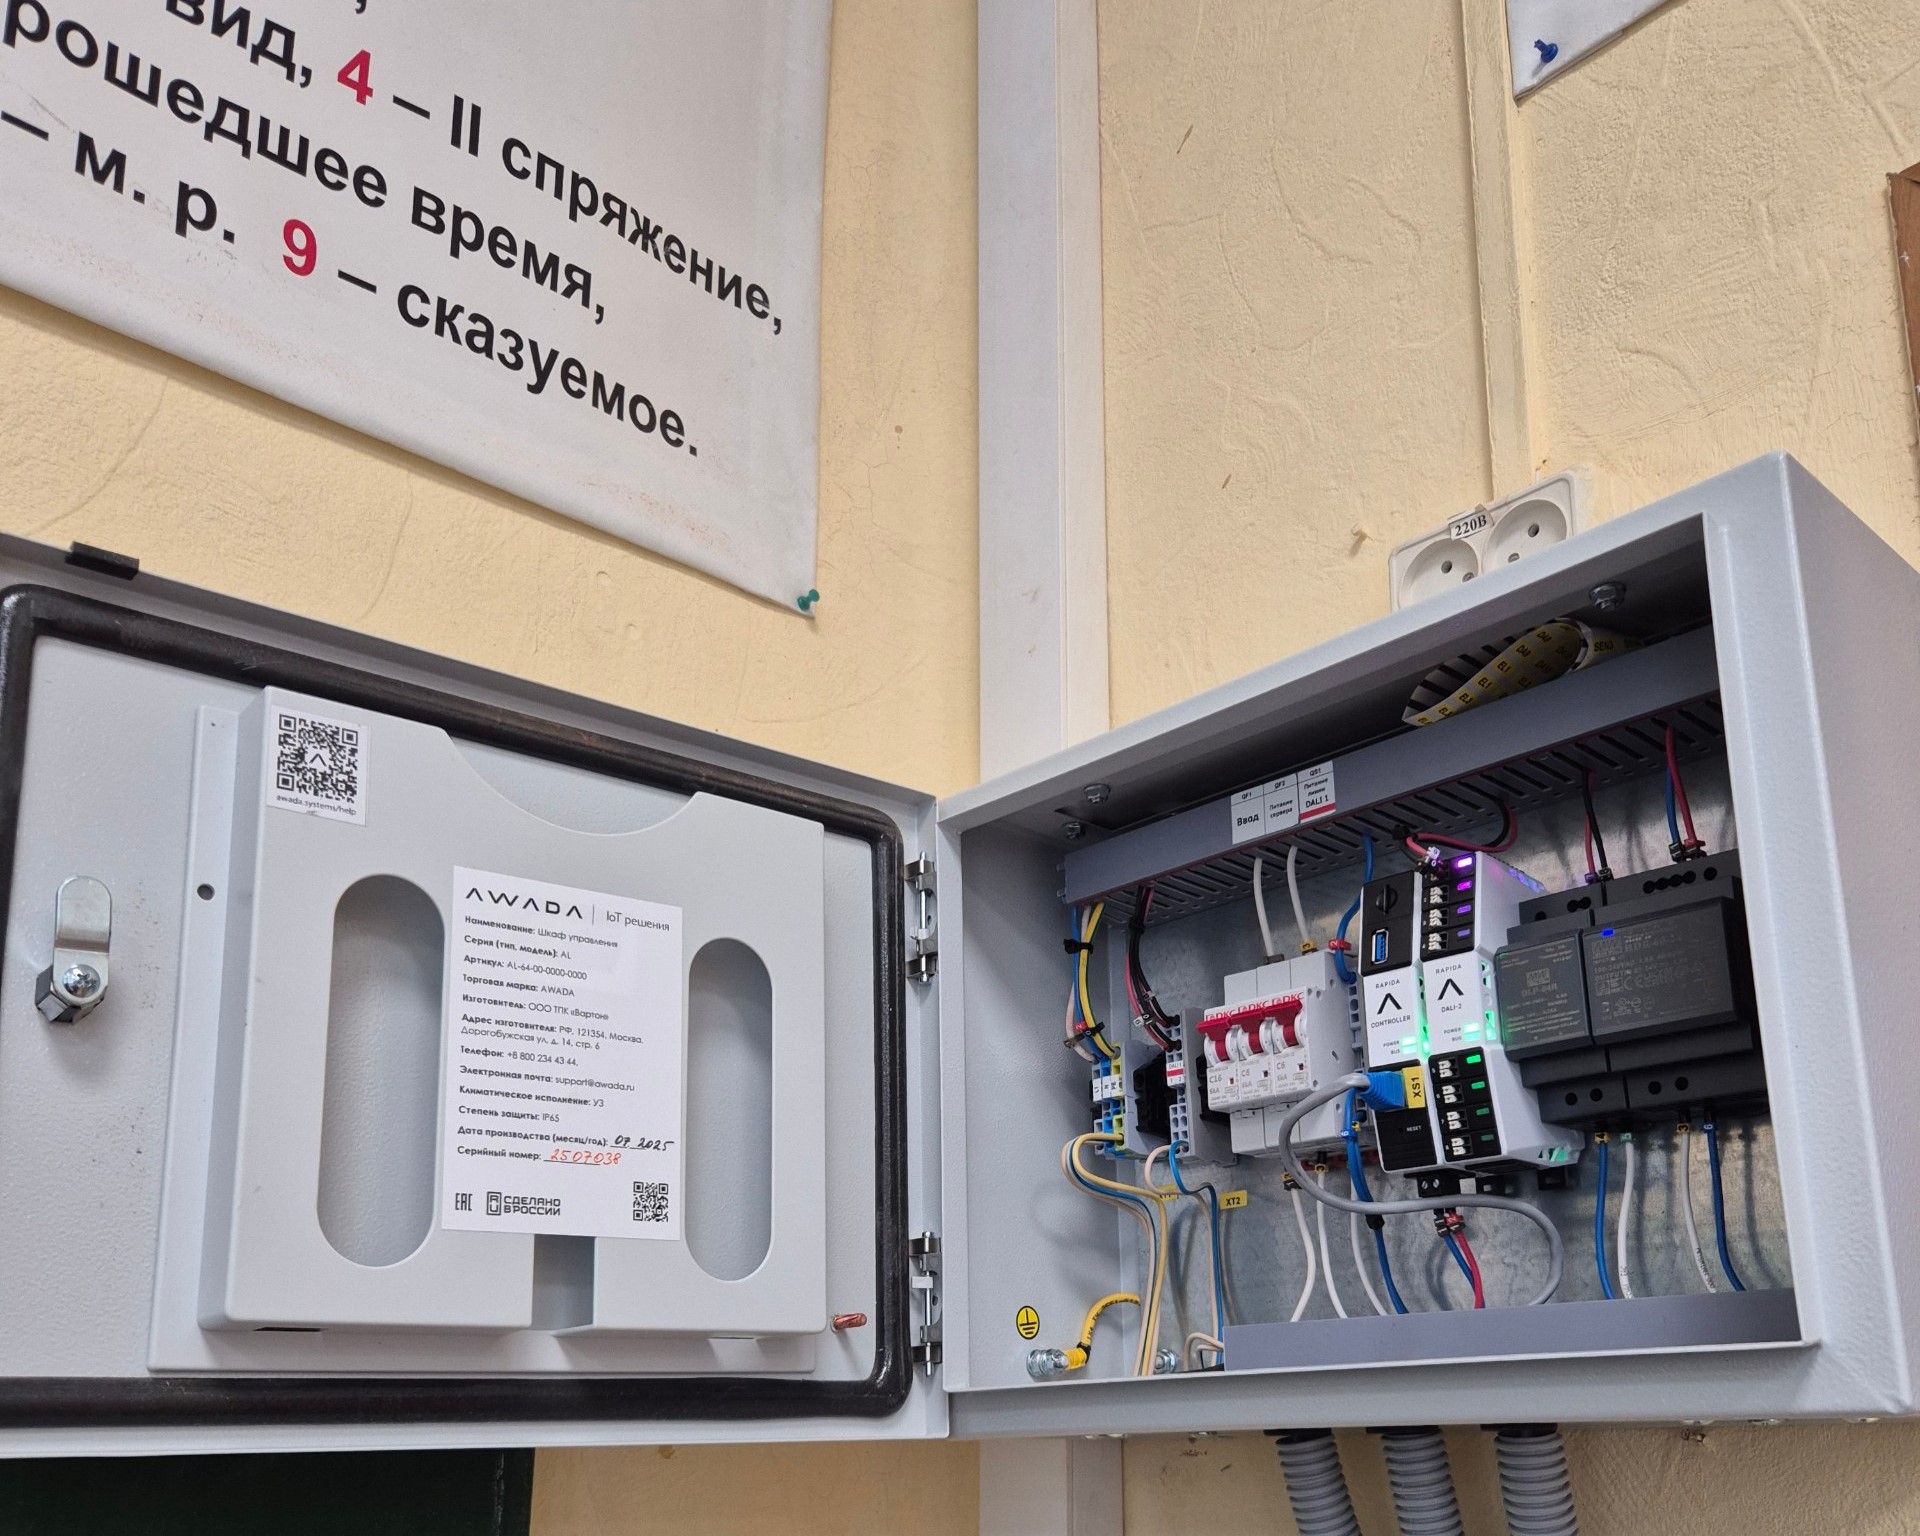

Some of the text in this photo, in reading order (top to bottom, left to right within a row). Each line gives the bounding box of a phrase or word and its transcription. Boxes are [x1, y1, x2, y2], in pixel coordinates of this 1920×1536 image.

[337, 49, 374, 106] 4
[502, 137, 782, 336] спряжение,
[411, 186, 605, 325] время,
[74, 131, 146, 205] м.
[176, 180, 235, 244] р.
[282, 218, 318, 277] 9
[397, 284, 700, 457] сказуемое.
[1454, 514, 1487, 537] 220В
[276, 794, 357, 816] awada.systems/help
[1236, 814, 1259, 826] Ввод
[466, 887, 583, 920] AWADA
[606, 910, 670, 931] IoT решения
[465, 916, 618, 948] Наименование: Шкаф управления
[464, 935, 494, 947] Серия
[519, 945, 558, 958] модель):
[561, 951, 572, 959] AL
[464, 954, 587, 980] Артикул: AL-64-00-0000-0000
[1435, 963, 1463, 975] RAPIDA
[463, 974, 575, 996] Торговая марка: AWADA
[1375, 978, 1401, 989] RAPIDA
[462, 994, 609, 1021] Изготовитель: ООО ТПК «Вартон»
[1441, 1003, 1462, 1013] DALI-2
[461, 1013, 492, 1025] Адрес
[495, 1019, 557, 1032] изготовителя:
[1370, 1014, 1411, 1029] CONTROLLER
[460, 1045, 505, 1057] Телефон:
[507, 1051, 518, 1059] +8
[519, 1052, 535, 1061] 800
[537, 1054, 552, 1063] 234
[554, 1056, 565, 1064] 43
[575, 1041, 592, 1050] стр.
[595, 1042, 600, 1050] 6
[460, 1065, 635, 1092] Электронная почта: support@awada.ru
[1412, 1076, 1422, 1098] XS1
[459, 1085, 533, 1100] Климатическое
[535, 1094, 591, 1106] исполнение:
[458, 1105, 560, 1123] Степень защиты: IP65
[457, 1126, 483, 1135] Дата
[485, 1129, 550, 1141] производства
[552, 1133, 609, 1147] (месяц/год):
[637, 1137, 675, 1151] 2025
[1406, 1124, 1422, 1132] RESET
[457, 1145, 621, 1165] Серийный номер: 2507038
[503, 1195, 561, 1207] СДЕЛАНО
[1226, 1196, 1241, 1206] XT2
